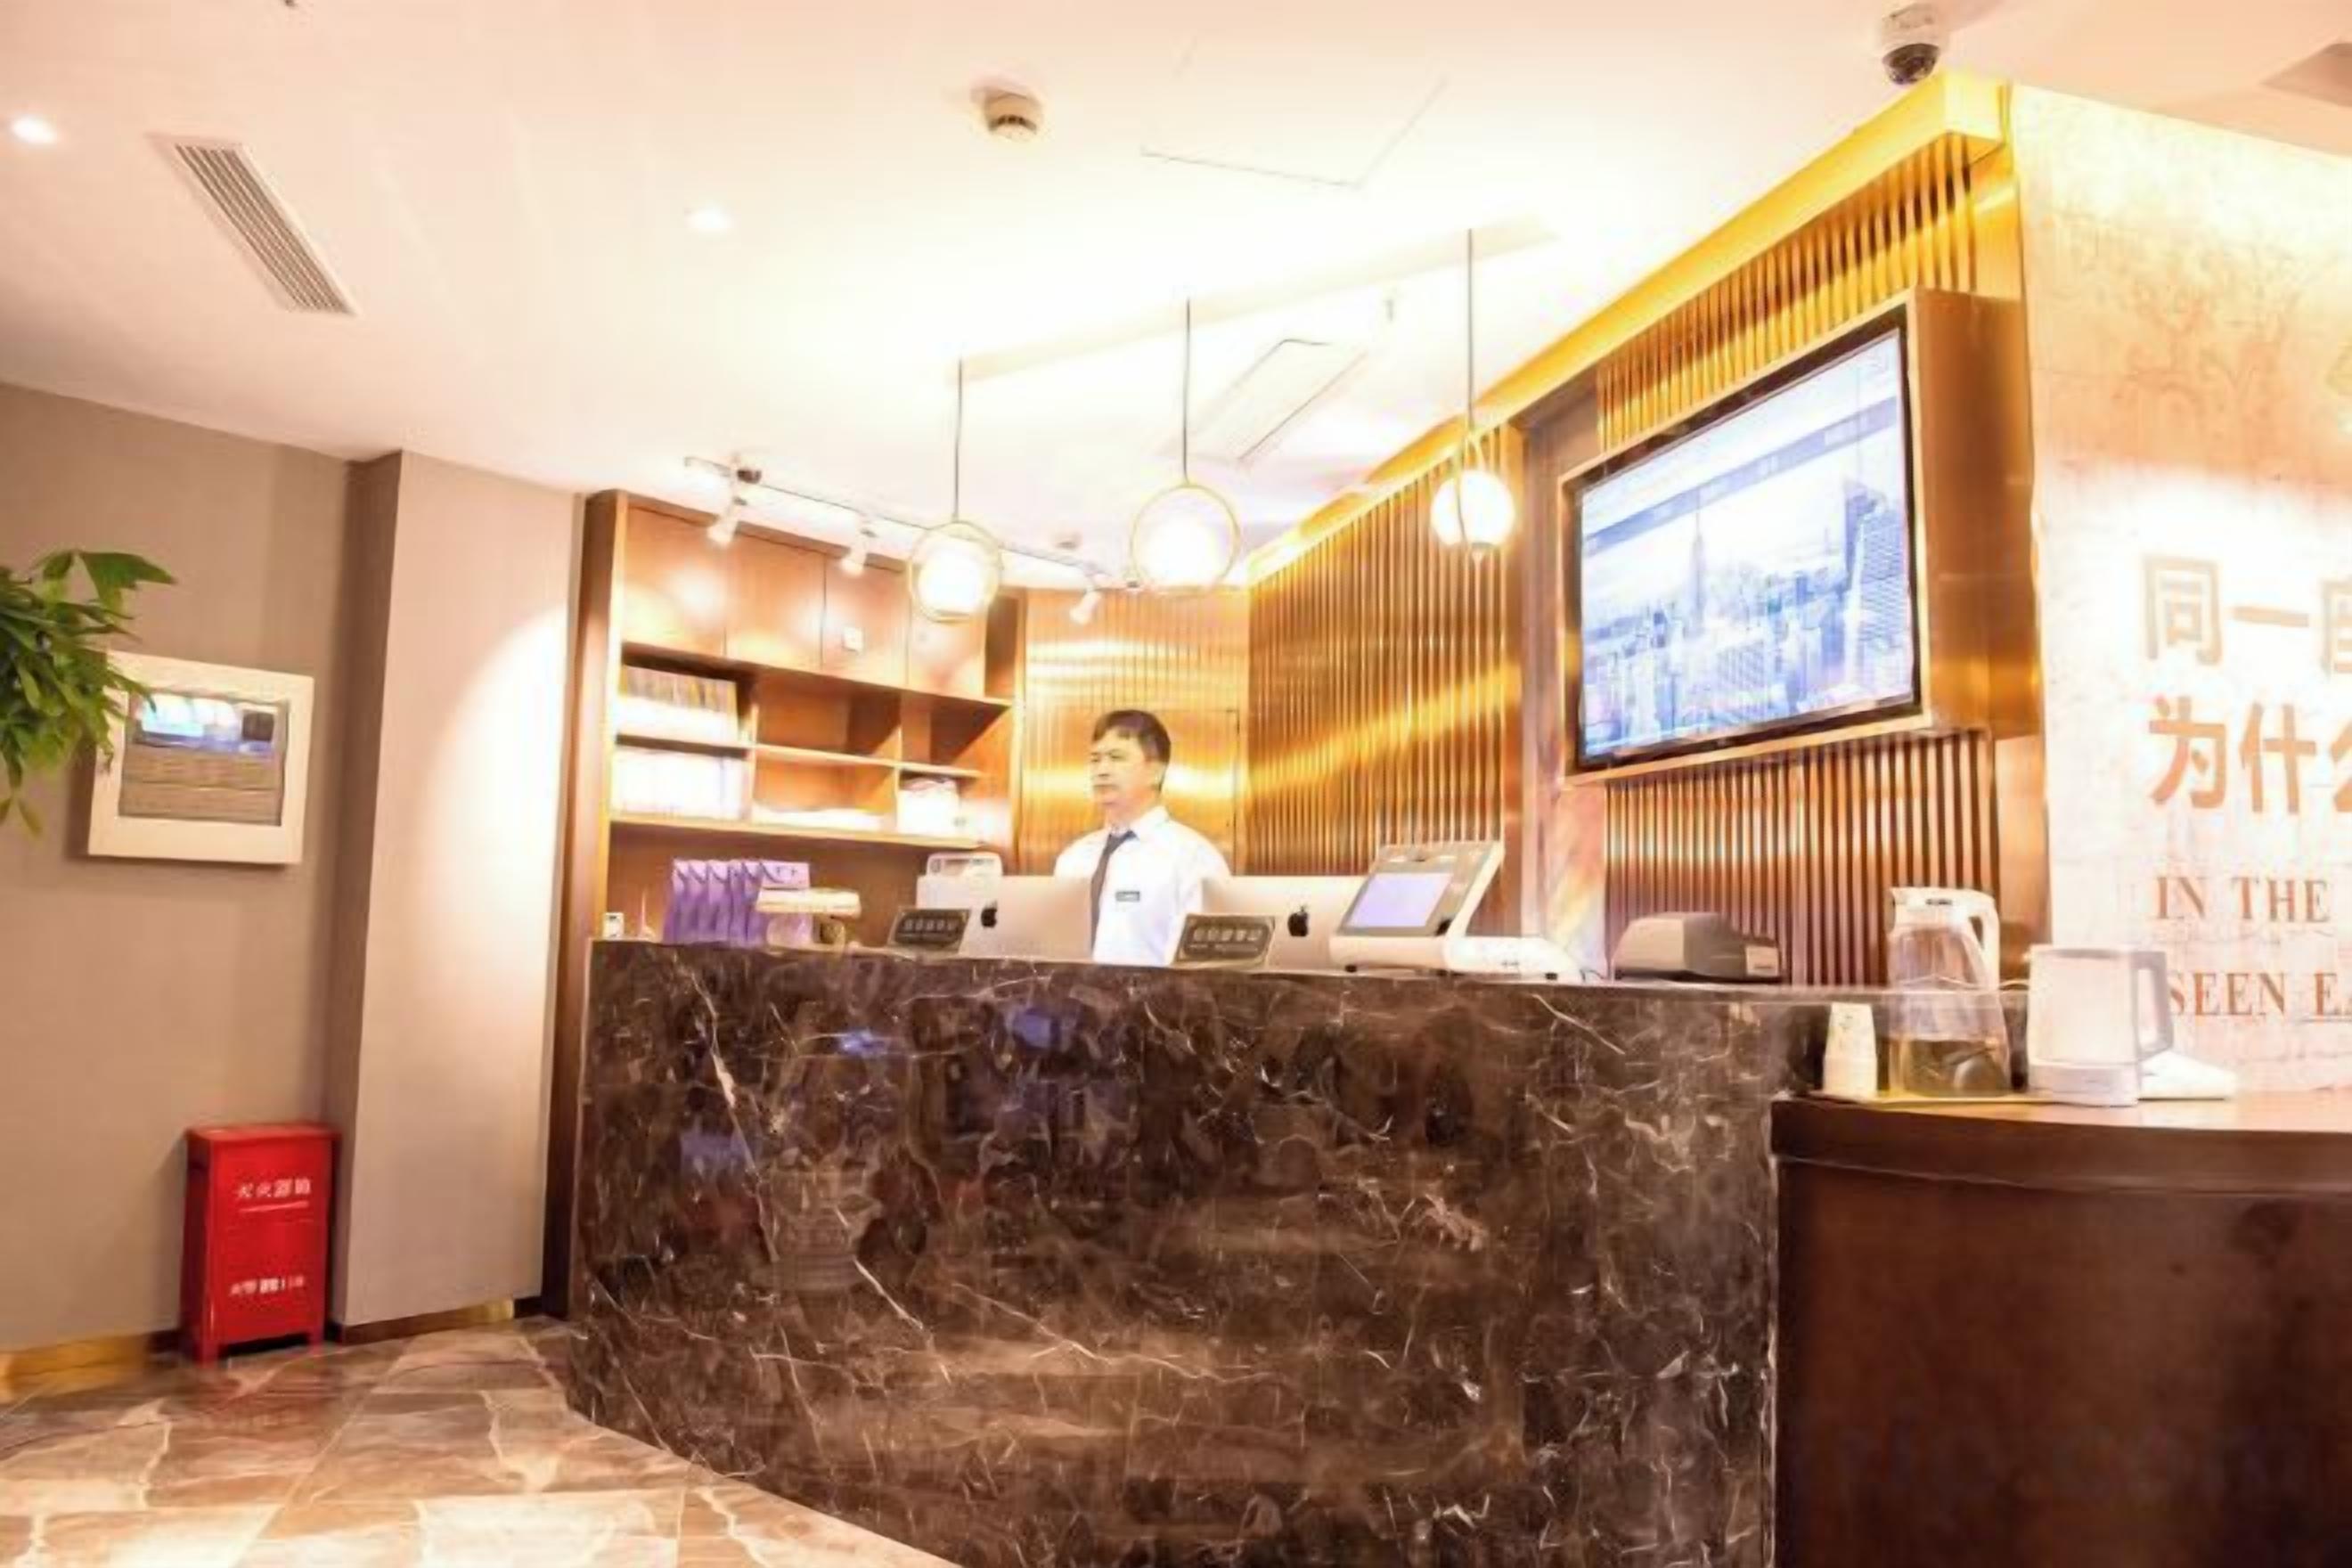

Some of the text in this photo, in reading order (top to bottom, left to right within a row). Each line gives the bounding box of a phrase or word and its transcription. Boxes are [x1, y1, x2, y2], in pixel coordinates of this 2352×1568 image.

[2157, 877, 2330, 922] IN THE
[2315, 972, 2352, 1016] E
